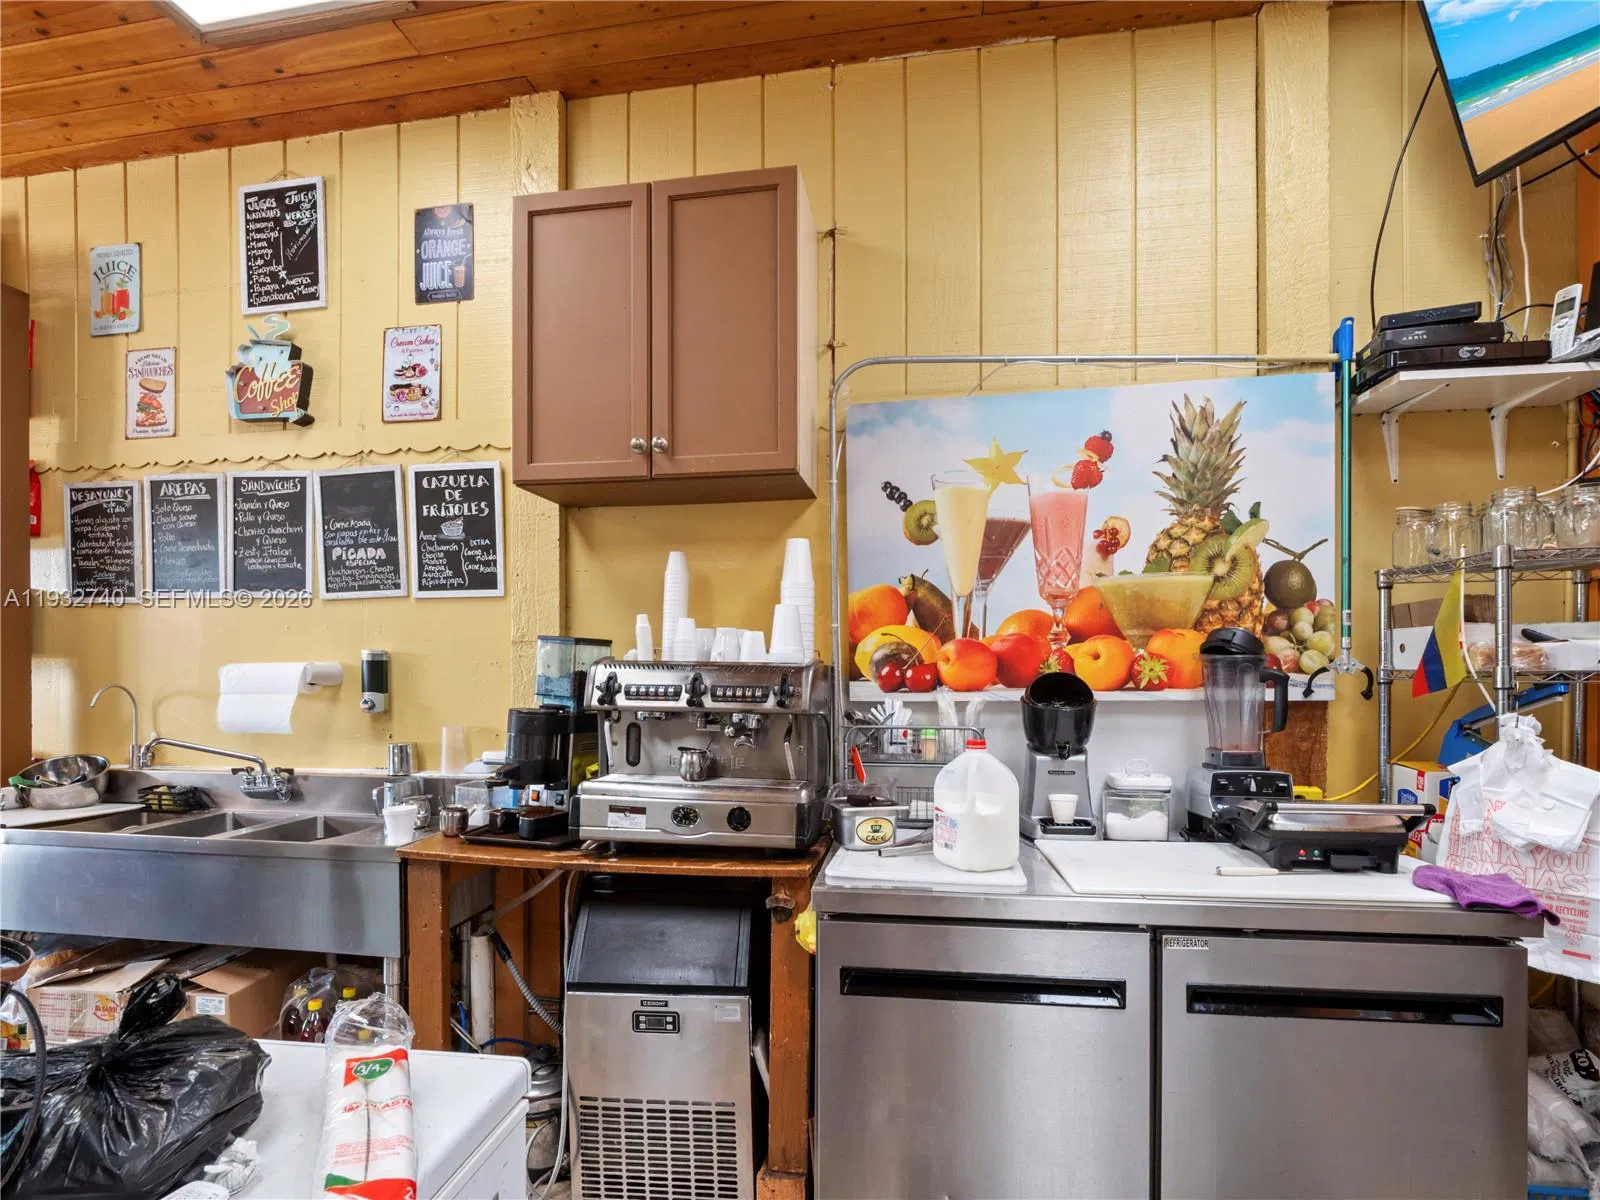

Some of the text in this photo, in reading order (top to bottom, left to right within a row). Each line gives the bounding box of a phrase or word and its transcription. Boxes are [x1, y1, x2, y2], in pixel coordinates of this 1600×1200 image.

[246, 196, 277, 211] JUGOS
[285, 190, 317, 205] JUGOS
[285, 209, 317, 220] VERDES
[251, 248, 273, 260] Mango
[421, 239, 466, 260] ORANGE
[93, 260, 137, 283] JUICE
[419, 261, 453, 291] JUICE
[254, 282, 279, 295] Papaya
[391, 336, 414, 348] Cream
[270, 390, 299, 417] Shop
[421, 475, 490, 489] CAZUELA
[71, 488, 132, 502] DESAYUNOS
[160, 482, 207, 497] AREPAS
[445, 489, 463, 501] DE
[269, 498, 290, 510] Queso
[238, 512, 255, 523] Pollo
[263, 511, 286, 521] Queso
[262, 536, 287, 545] Queso
[469, 538, 491, 547] EXTRA
[1530, 844, 1590, 876] YOU
[1555, 905, 1589, 919] RECYCLING
[1164, 938, 1209, 949] REFRIGERATOR
